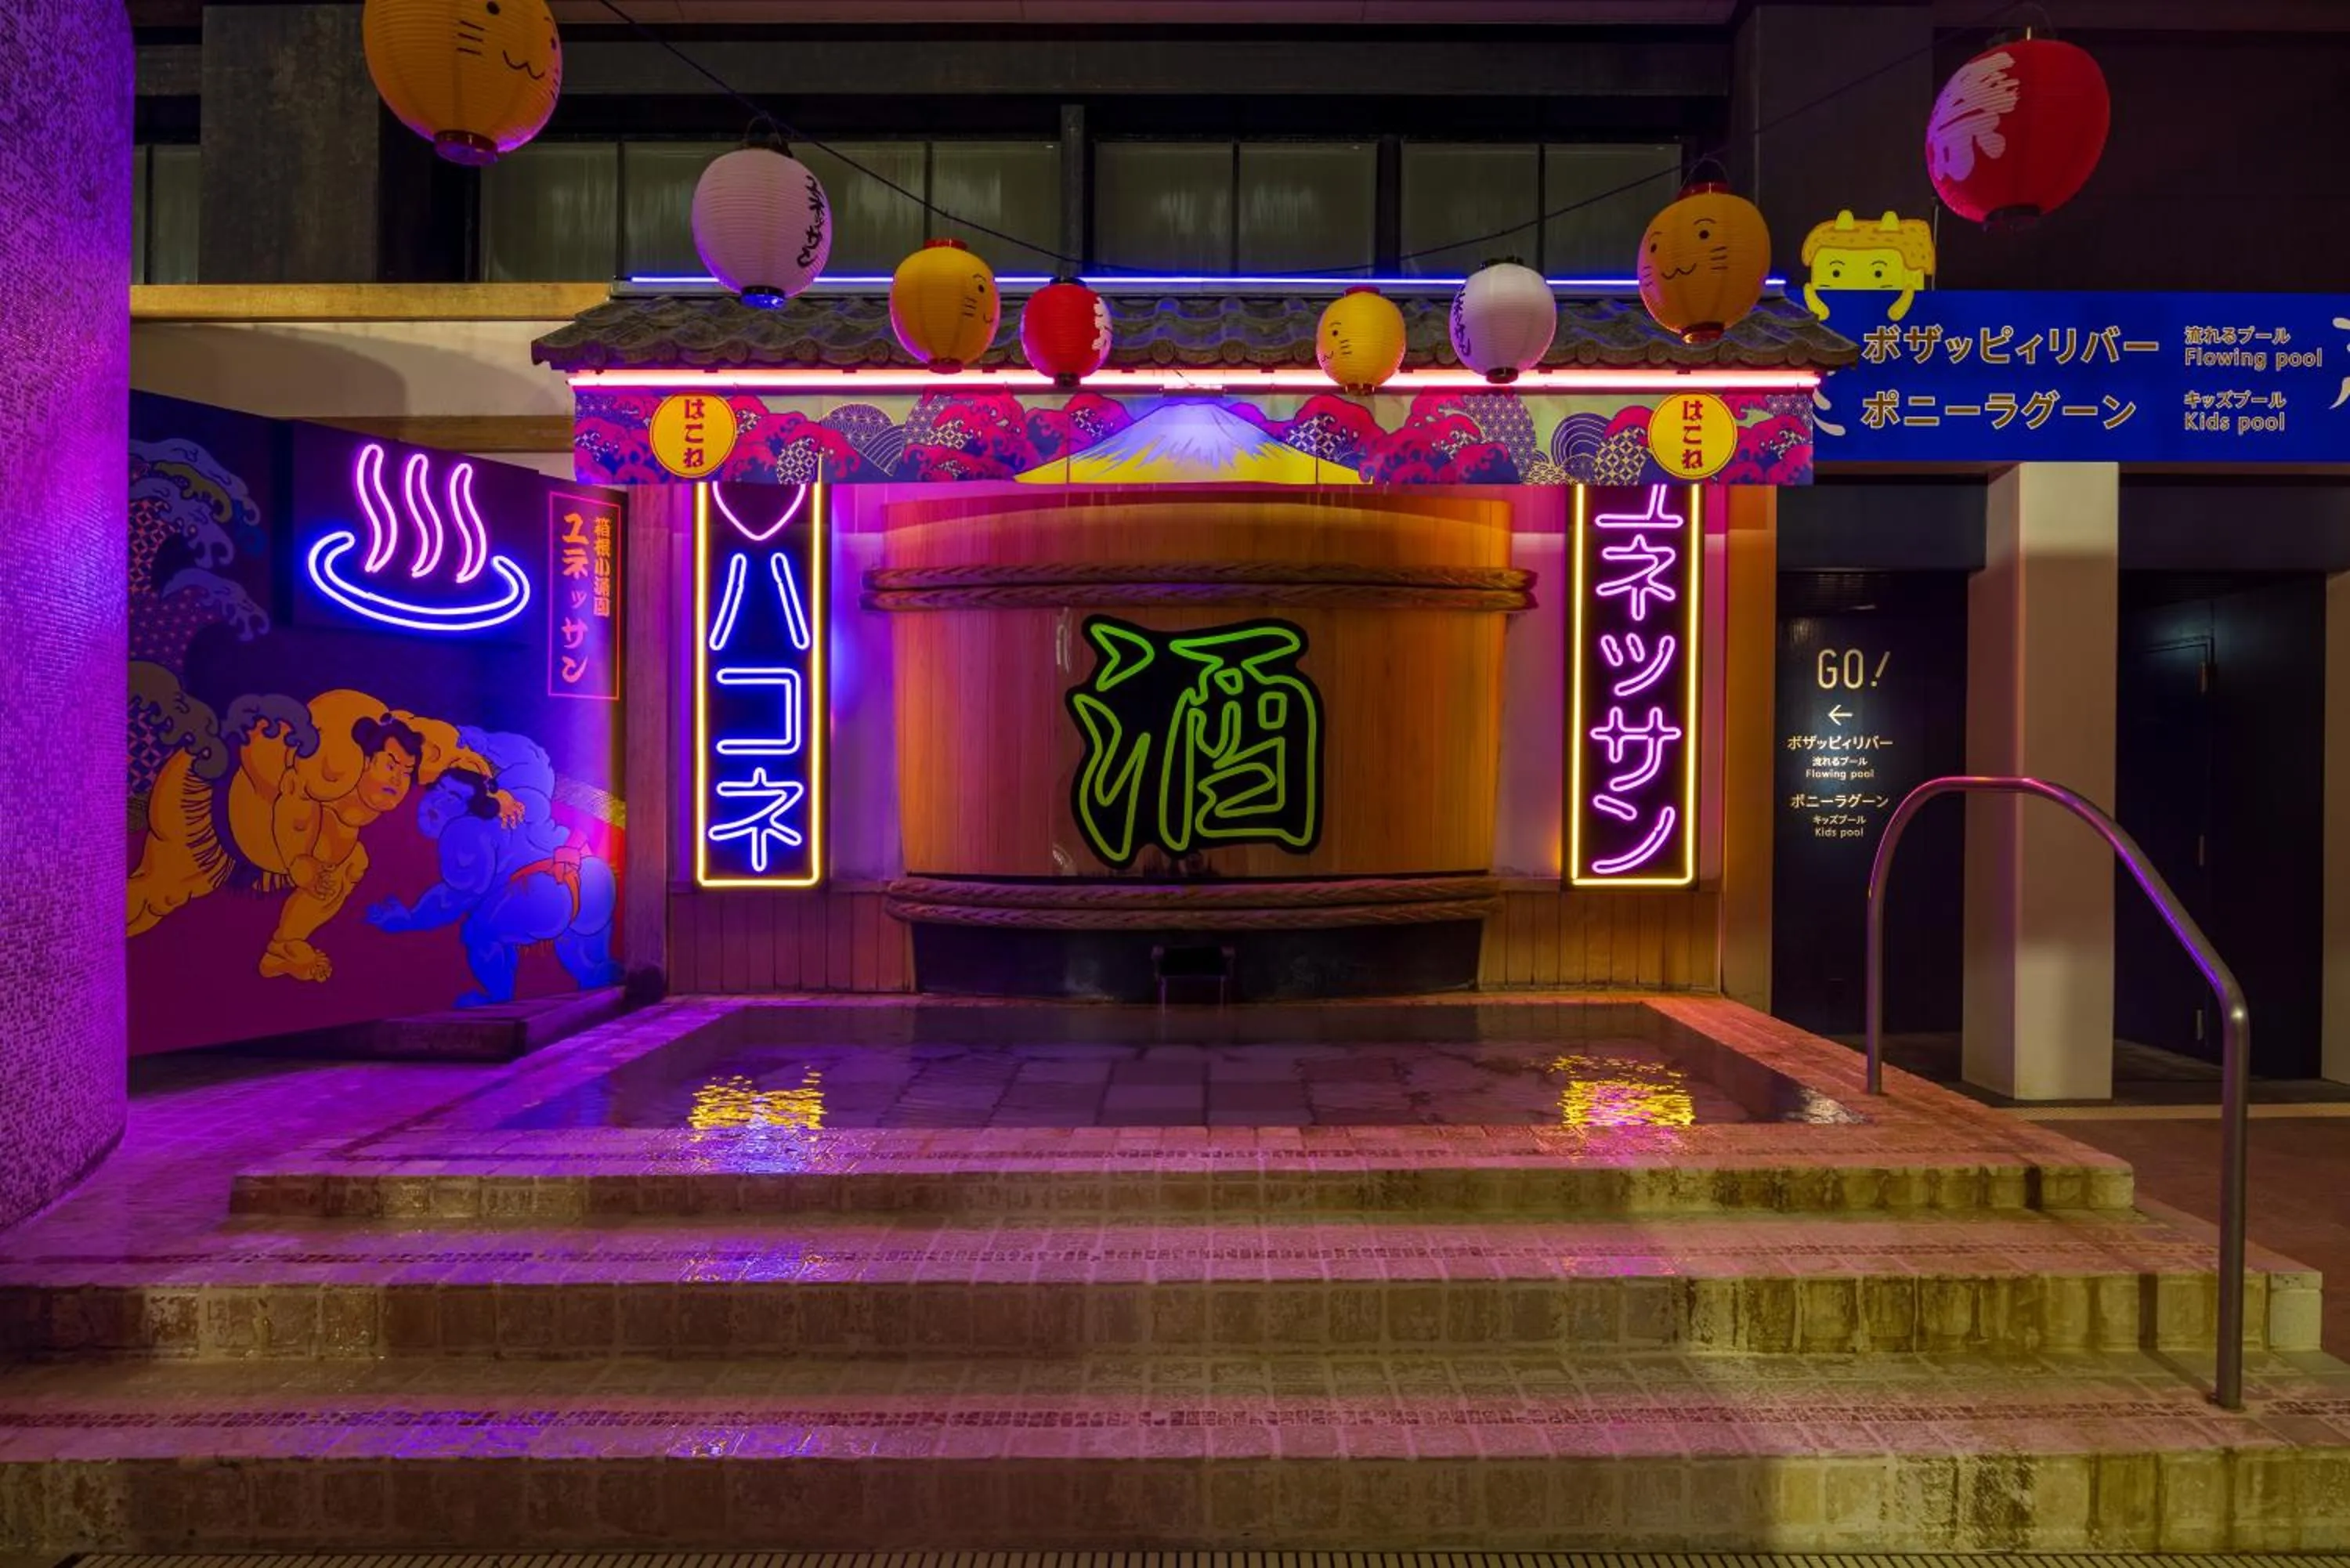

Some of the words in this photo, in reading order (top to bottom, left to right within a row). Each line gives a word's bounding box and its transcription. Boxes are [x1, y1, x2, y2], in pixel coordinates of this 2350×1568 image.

[1862, 324, 2160, 364] ボザッピィリバー
[2183, 326, 2291, 345] 流れるプール
[2184, 347, 2267, 372] Flowing
[2275, 347, 2323, 372] pool
[1861, 388, 2137, 431] ポニーラグーン
[2183, 391, 2287, 410] キッズプール
[683, 399, 705, 468] はこね
[1682, 400, 1703, 469] はこね
[2184, 412, 2230, 432] Kids
[2237, 411, 2286, 435] pool
[562, 512, 588, 684] ユネッサン
[708, 552, 810, 872] ハコネ
[1787, 735, 1893, 750] ボザッピィリバー
[1812, 756, 1868, 767] 流れるプール
[1806, 769, 1846, 781] Flowing
[1850, 769, 1875, 781] pool
[1813, 814, 1867, 825] キッズプール
[1815, 826, 1837, 837] Kids
[1840, 826, 1864, 839] pool
